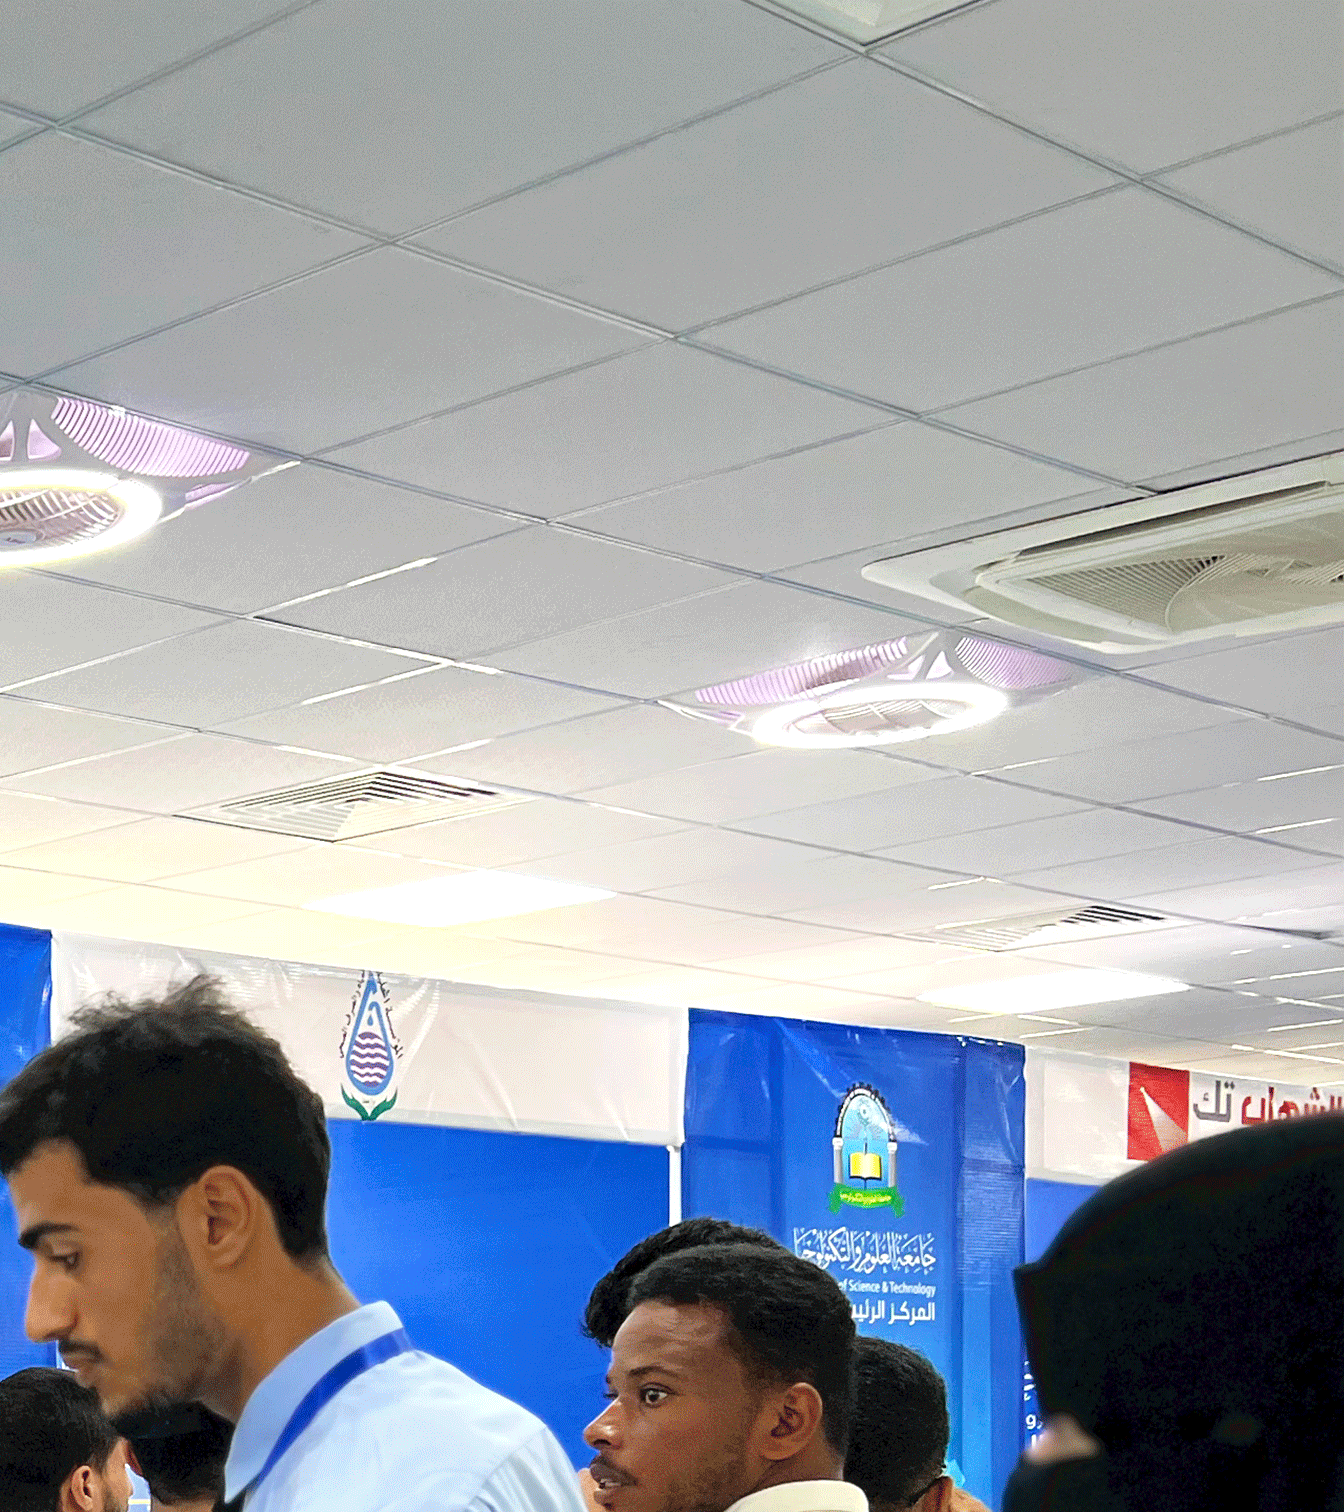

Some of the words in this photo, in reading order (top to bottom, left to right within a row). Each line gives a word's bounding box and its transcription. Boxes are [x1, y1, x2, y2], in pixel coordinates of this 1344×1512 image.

[849, 1279, 881, 1293] Science
[889, 1281, 937, 1298] Technology
[888, 1301, 936, 1326] المركز
